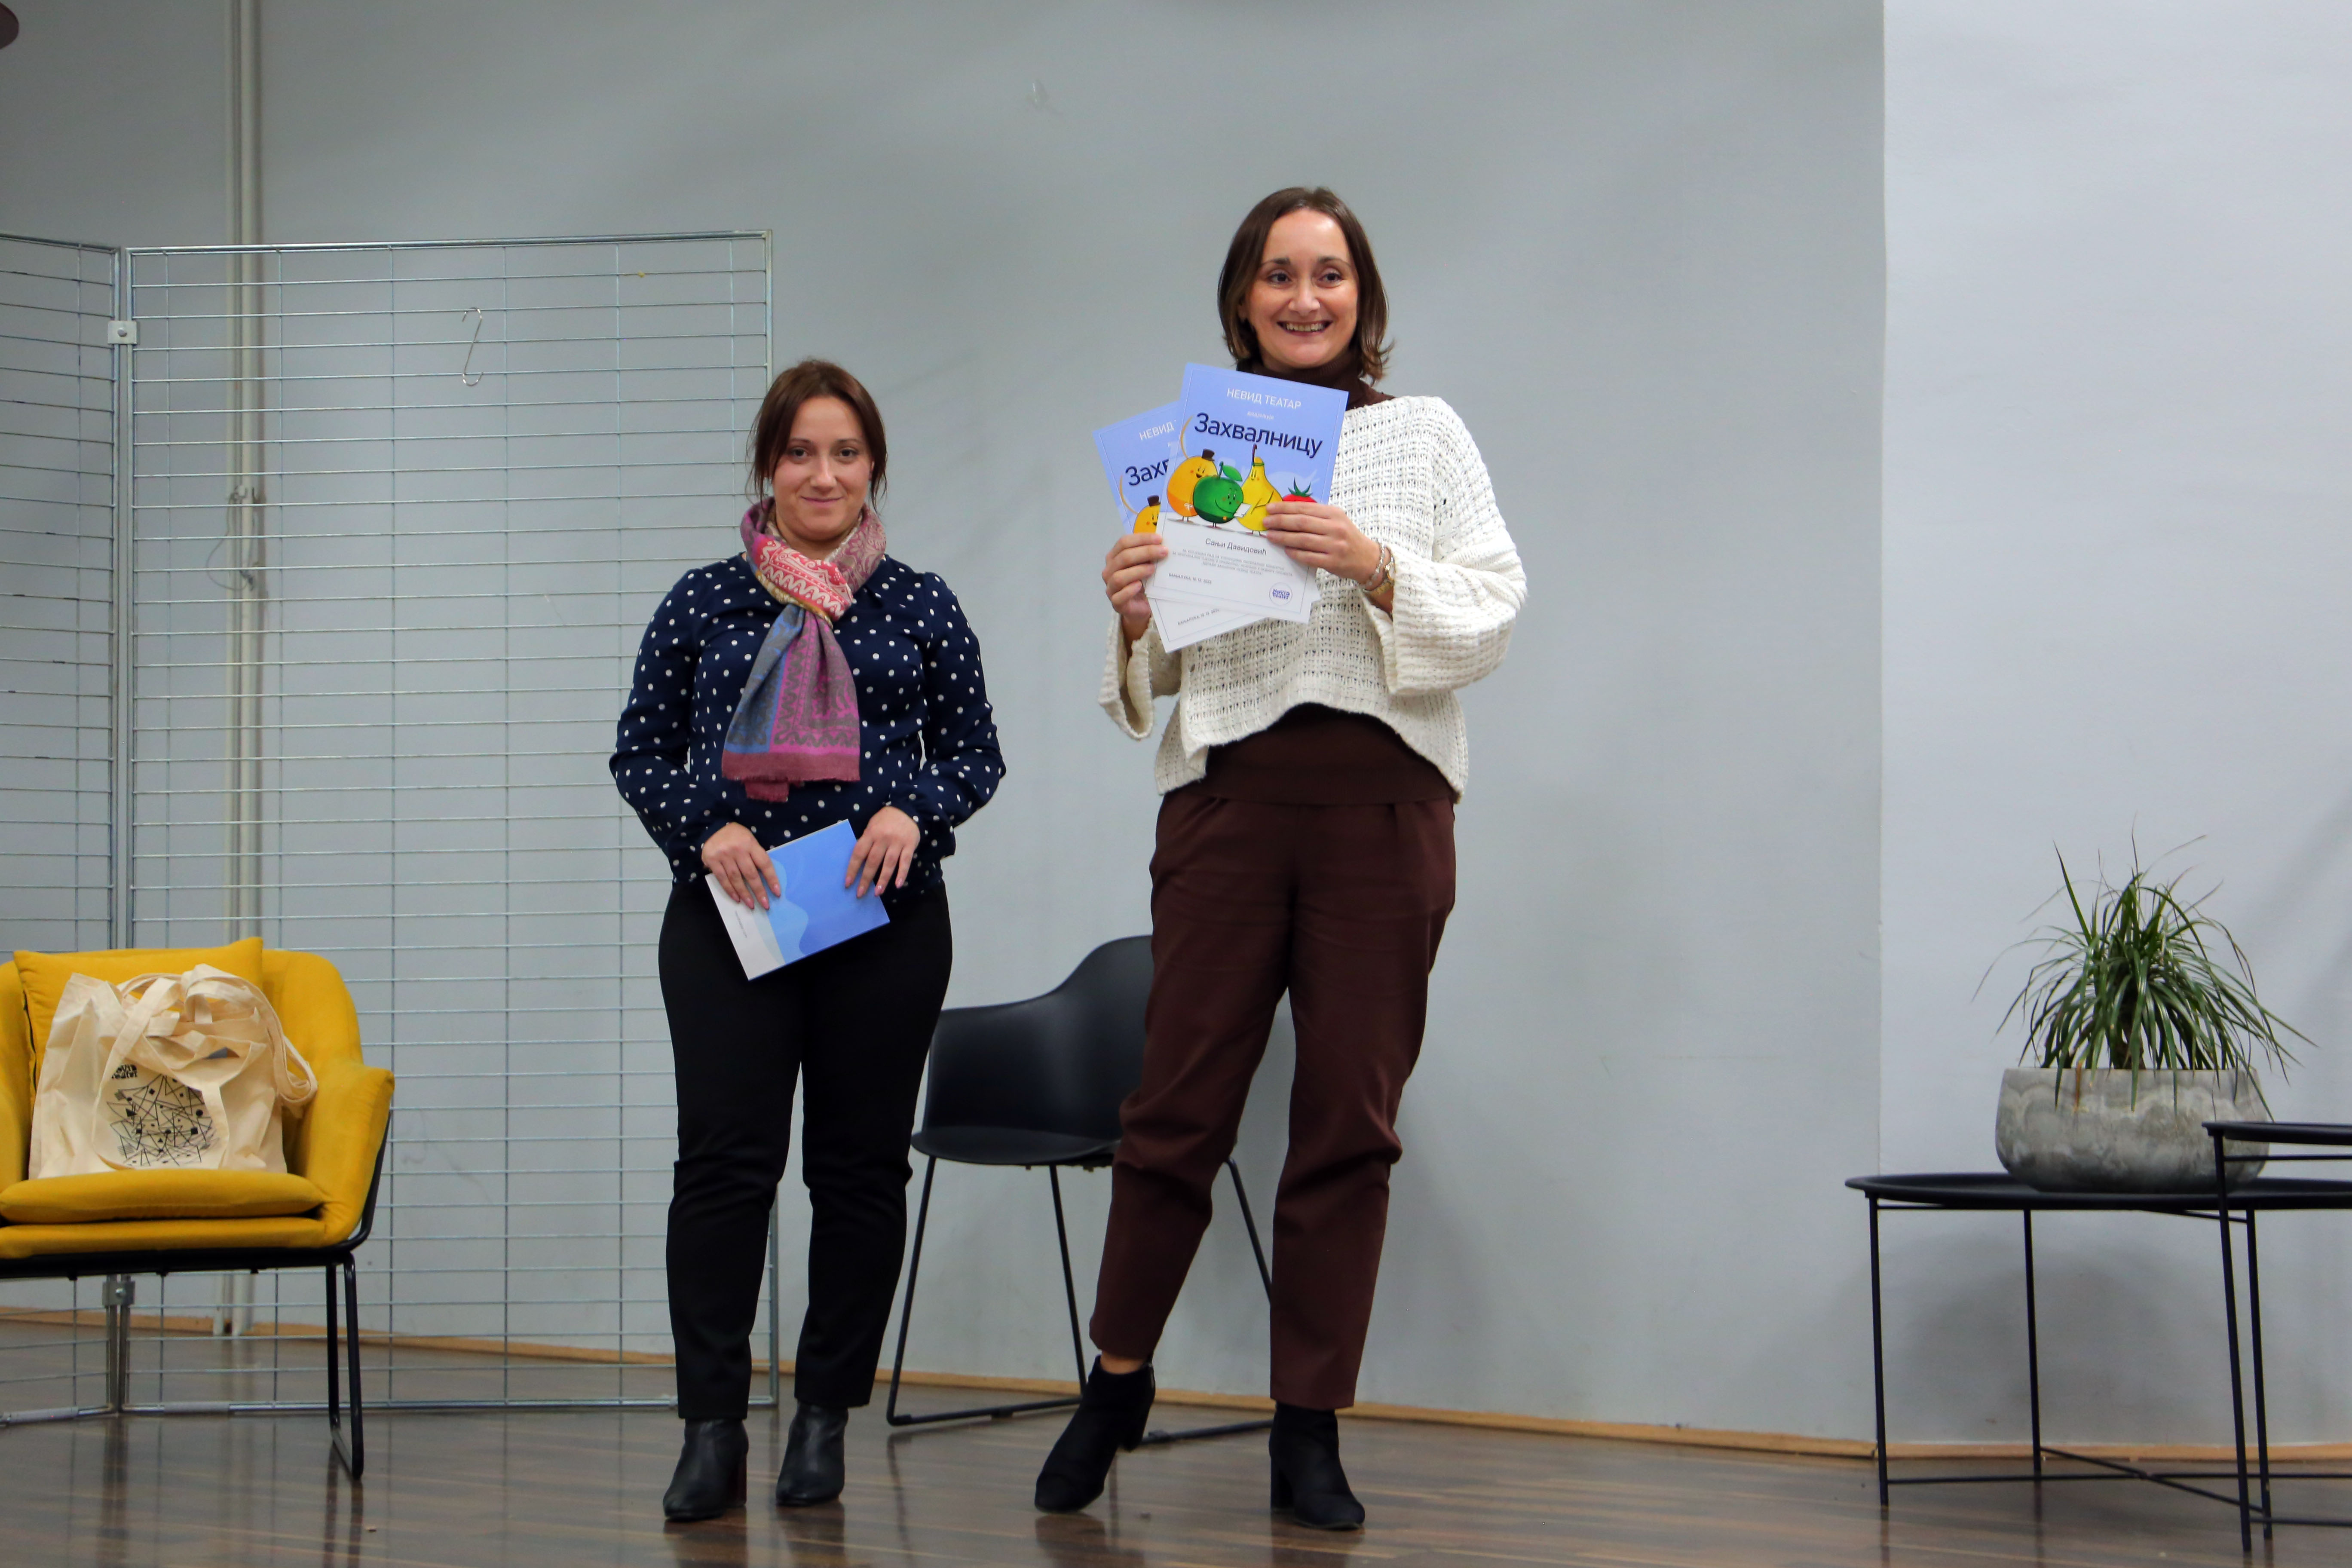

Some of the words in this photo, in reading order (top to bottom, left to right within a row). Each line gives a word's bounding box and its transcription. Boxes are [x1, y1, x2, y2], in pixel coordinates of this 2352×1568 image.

[1227, 388, 1262, 405] НЕВИД
[1265, 395, 1302, 409] ТЕАТАР
[1139, 421, 1175, 441] НЕВИД
[1194, 412, 1323, 459] Захвалницу
[1205, 538, 1226, 548] Сањи
[1227, 542, 1267, 555] Давидовић
